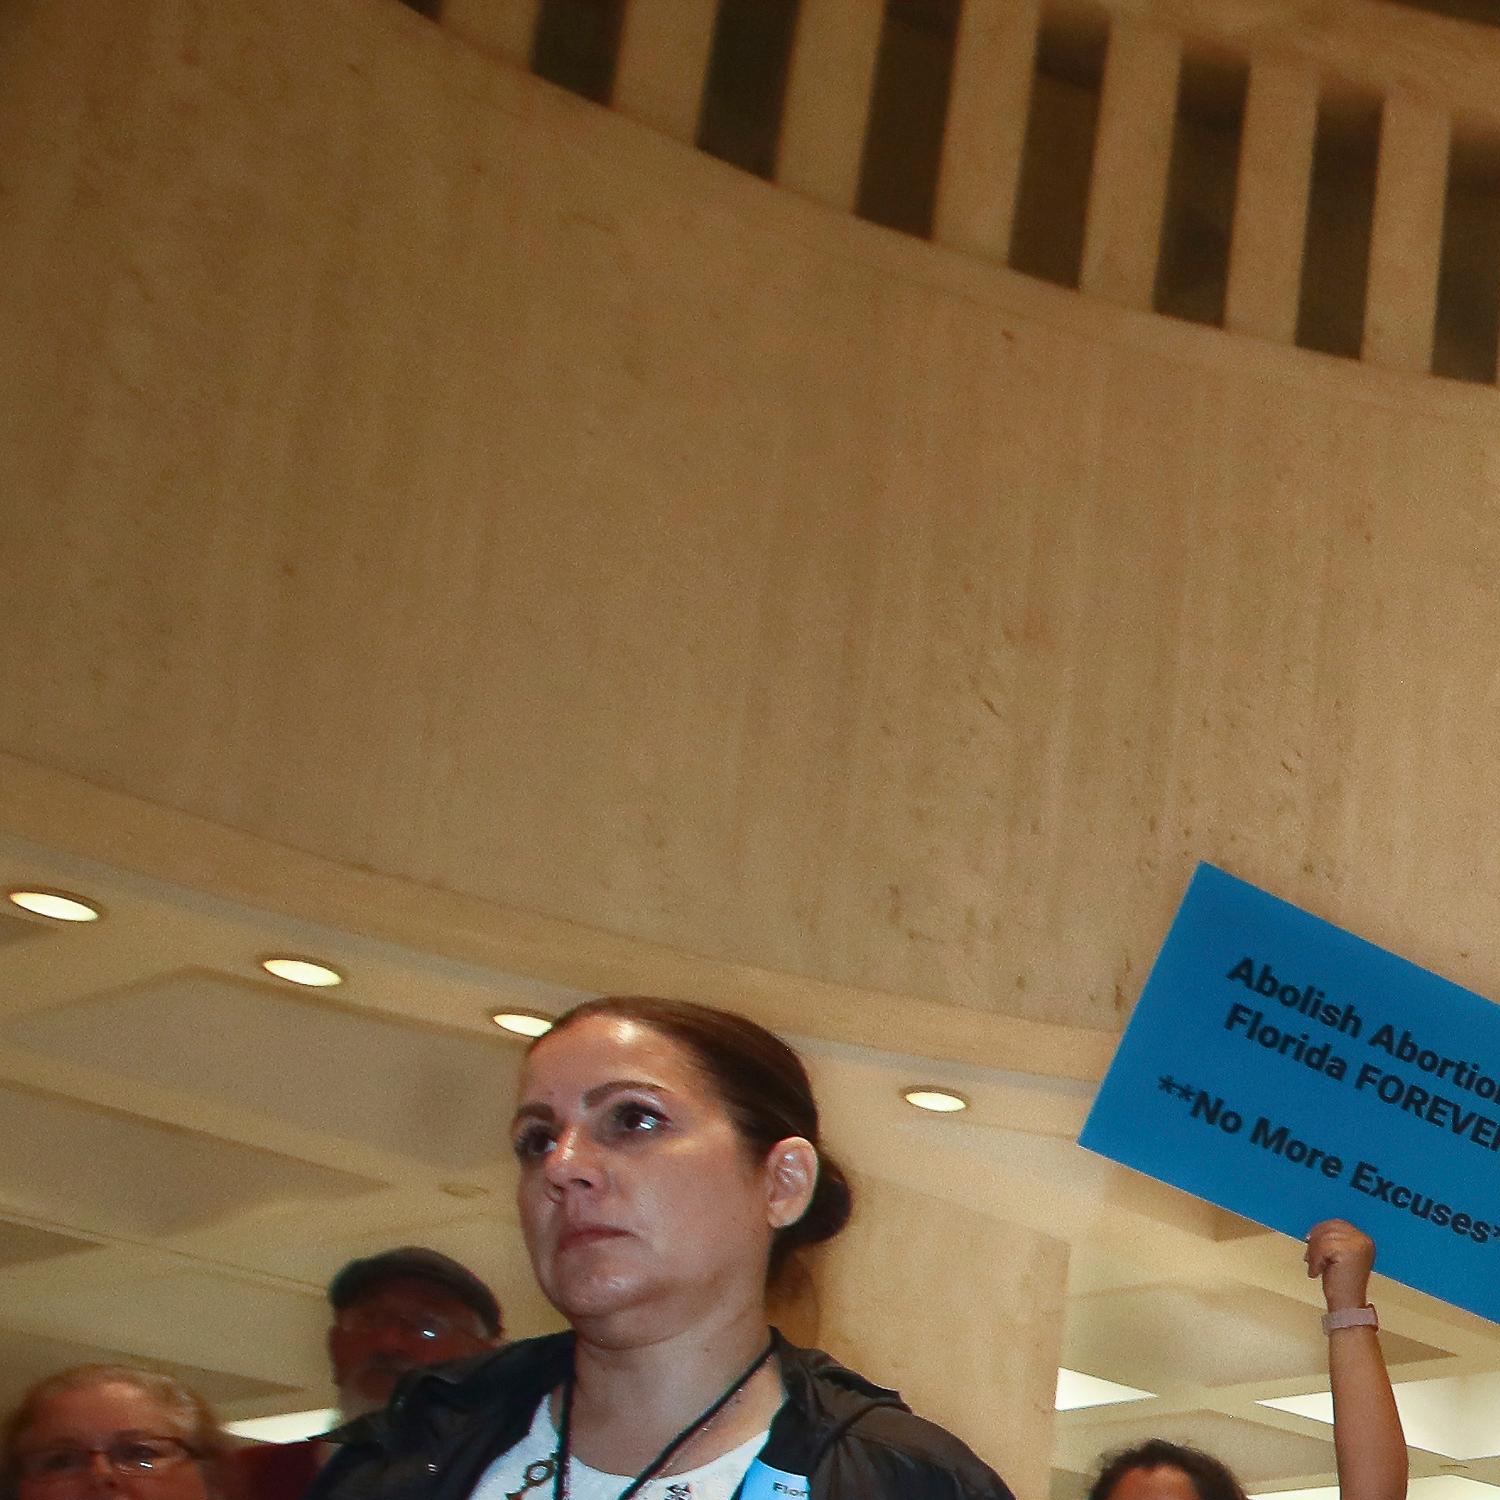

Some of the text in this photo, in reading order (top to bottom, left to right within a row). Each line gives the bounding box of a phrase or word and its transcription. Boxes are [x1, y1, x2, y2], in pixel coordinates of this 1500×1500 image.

[1226, 956, 1364, 1038] Abolish
[1224, 1002, 1348, 1081] Florida
[1250, 1115, 1344, 1179] More
